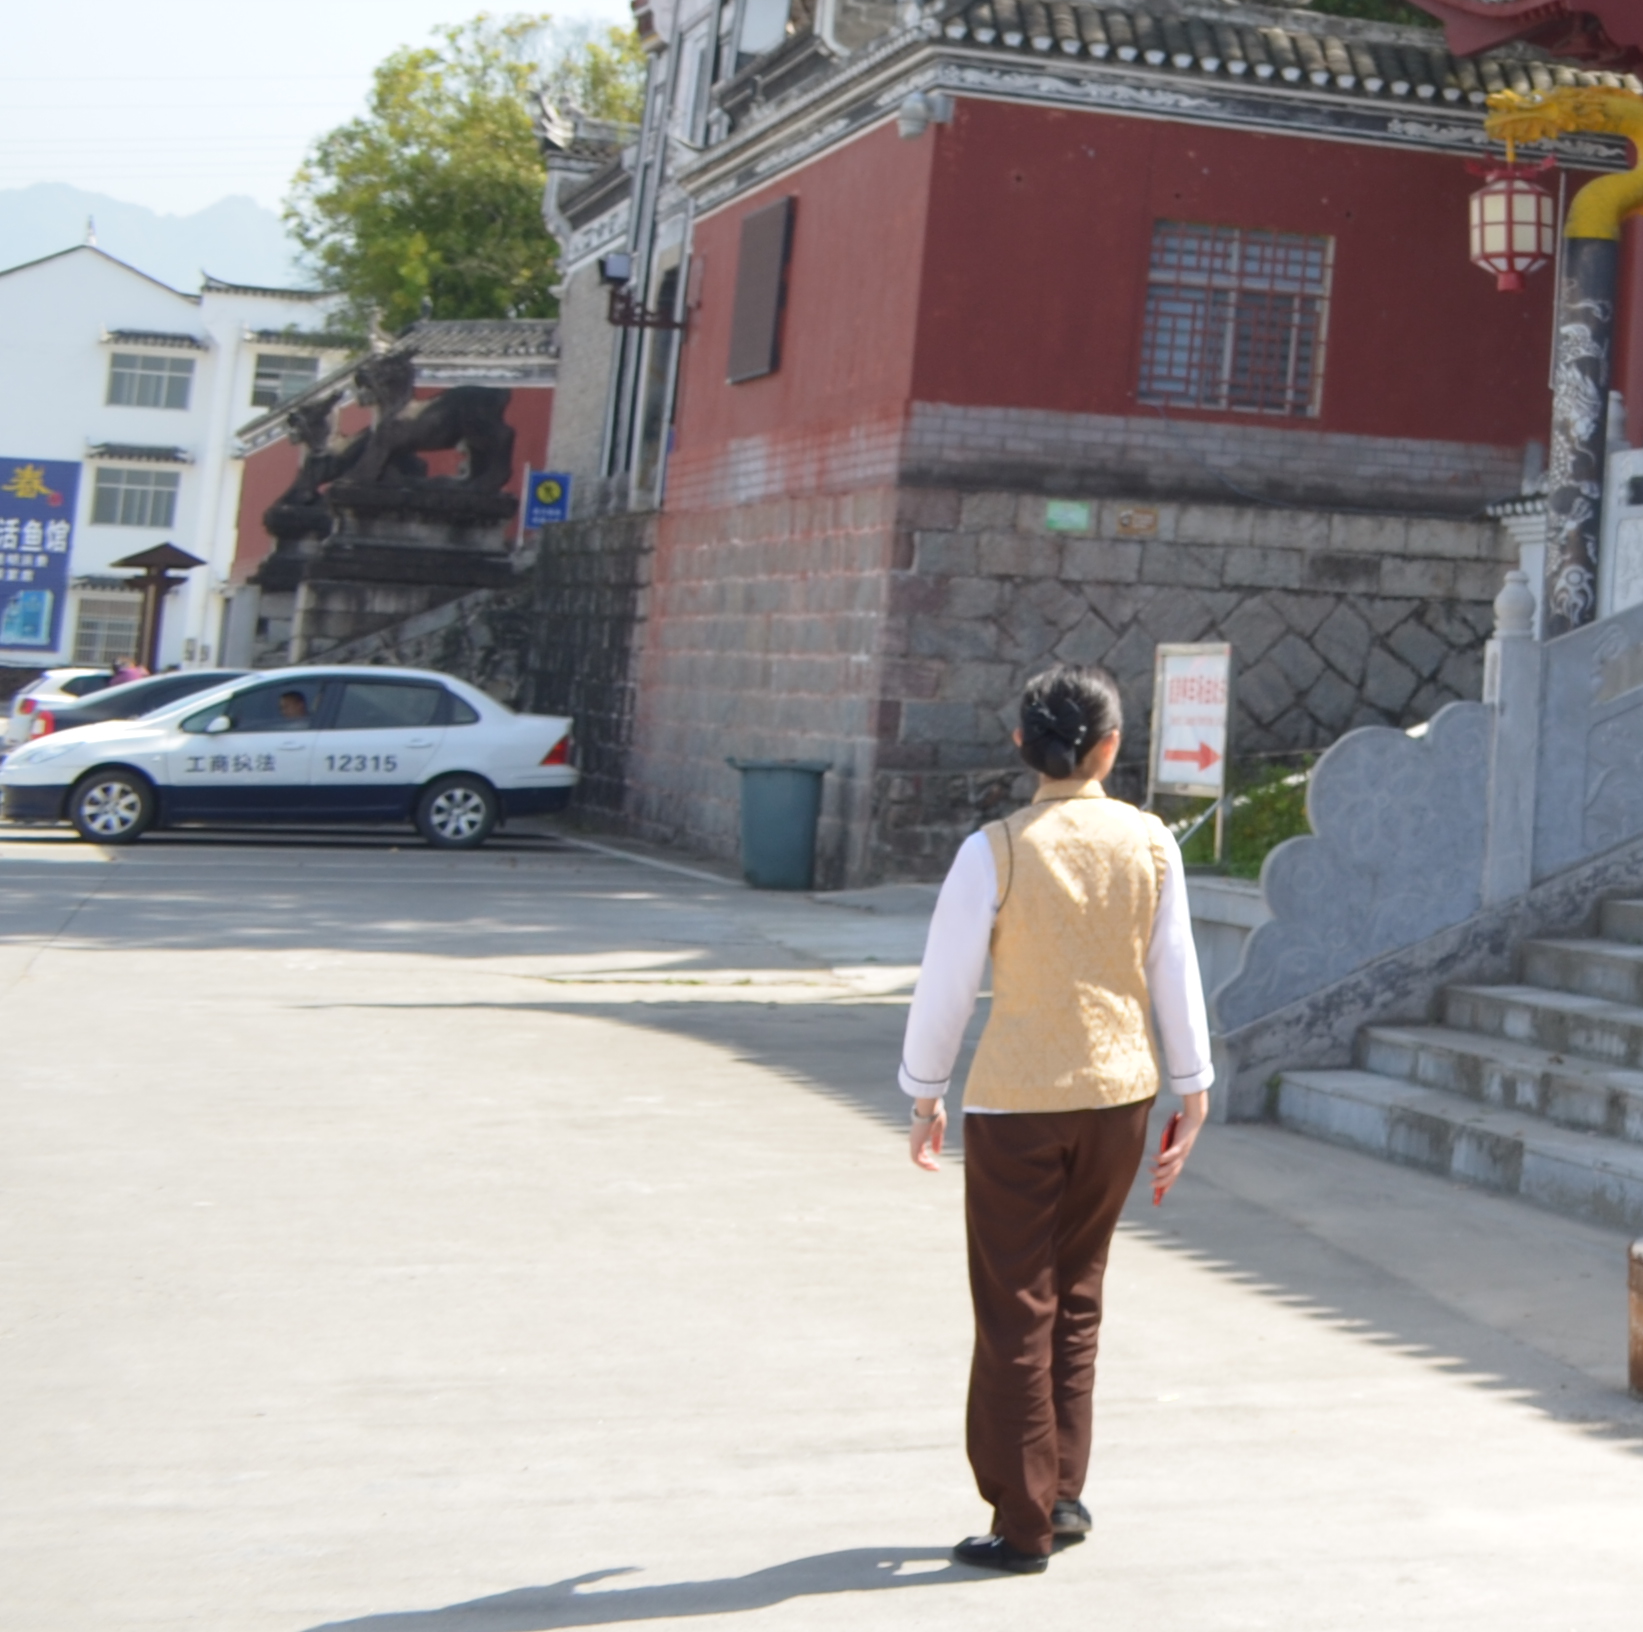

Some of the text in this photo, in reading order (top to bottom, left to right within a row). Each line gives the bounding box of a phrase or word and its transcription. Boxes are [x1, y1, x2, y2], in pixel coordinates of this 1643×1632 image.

[185, 754, 398, 773] 工商执法 12315
